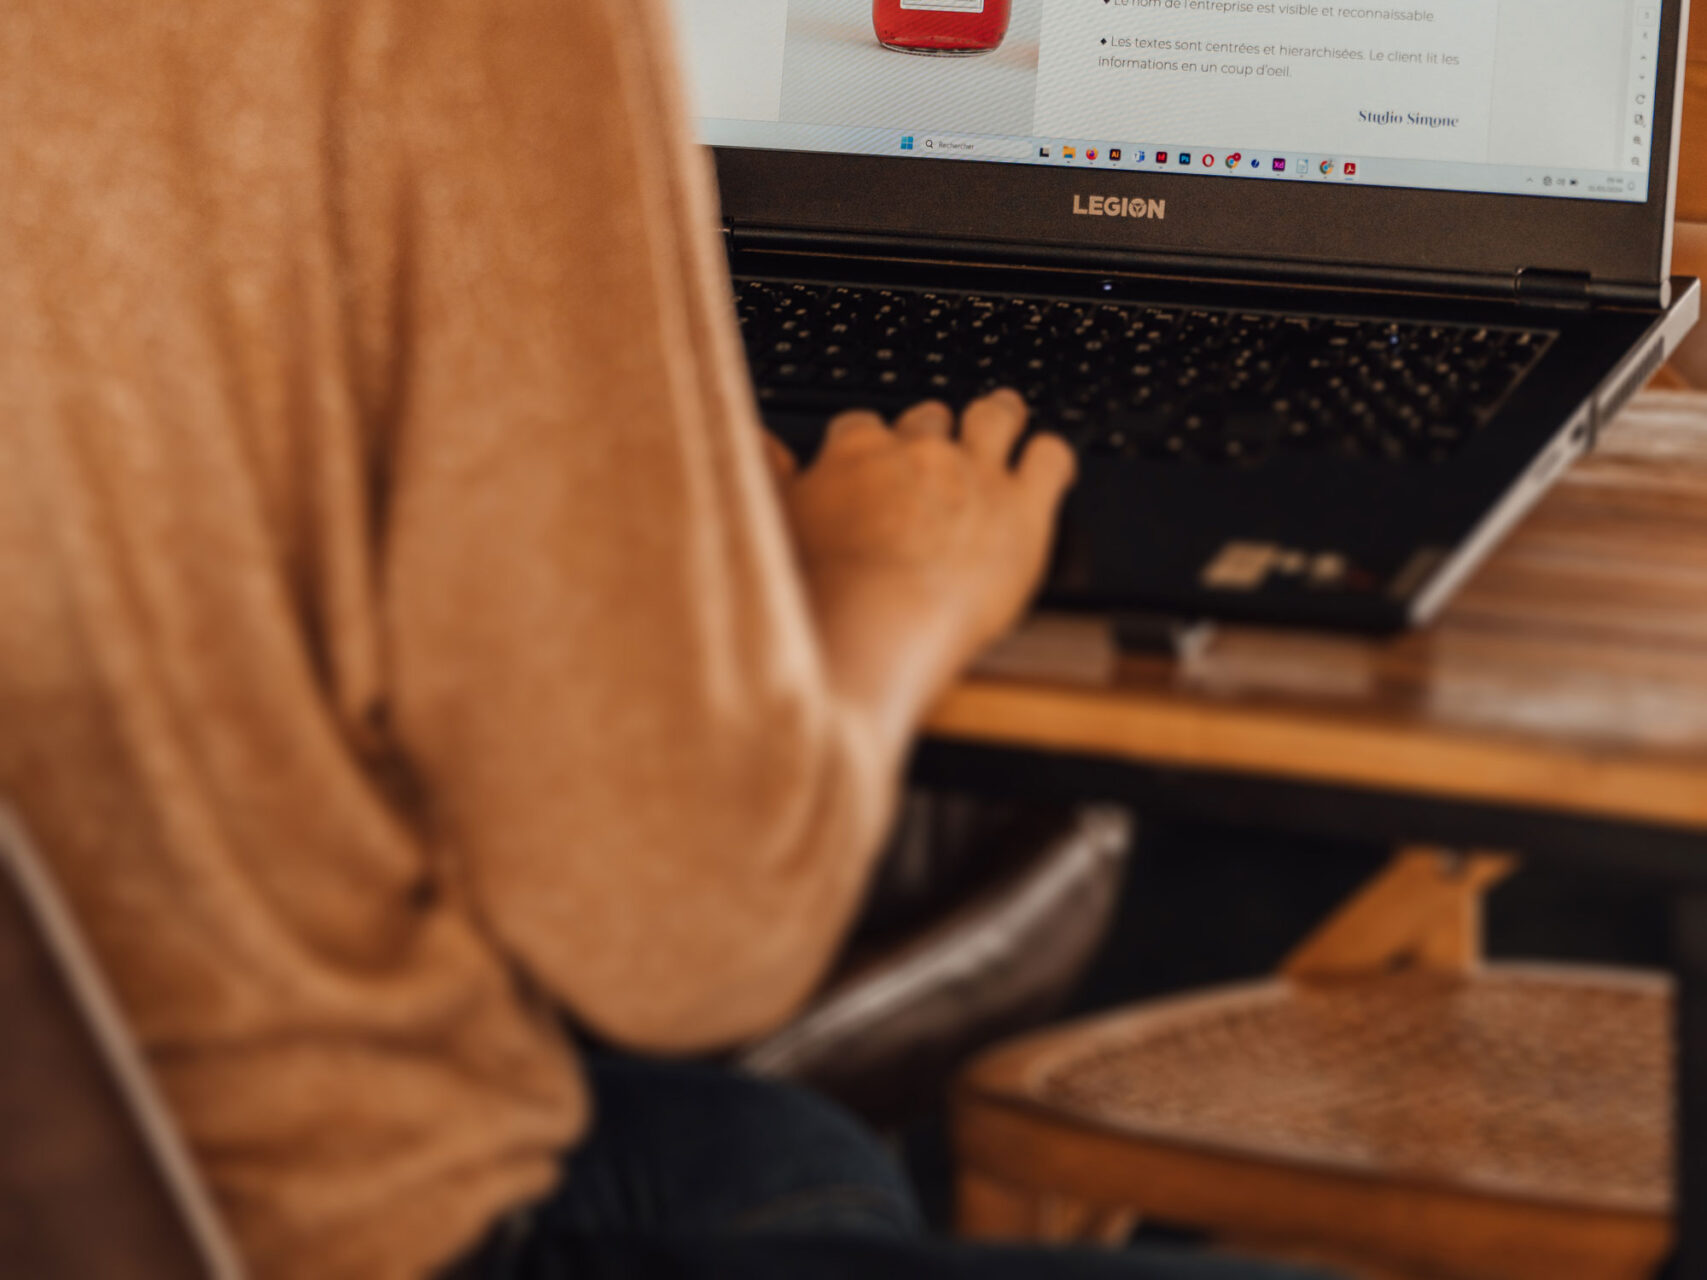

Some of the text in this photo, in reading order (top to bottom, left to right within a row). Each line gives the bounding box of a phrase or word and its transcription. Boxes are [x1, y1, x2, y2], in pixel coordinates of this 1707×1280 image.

[1257, 2, 1275, 13] est
[1278, 4, 1318, 16] visible
[1321, 6, 1334, 17] et
[1338, 7, 1434, 21] reconnaissable
[1111, 36, 1132, 47] Les
[1135, 37, 1172, 50] textes
[1174, 40, 1201, 51] sont
[1205, 41, 1259, 55] centrées
[1263, 44, 1275, 55] et
[1369, 48, 1384, 61] Le
[1387, 50, 1422, 64] client
[1426, 51, 1438, 64] lit
[1441, 52, 1460, 65] les
[1181, 62, 1197, 71] en
[1200, 63, 1217, 73] un
[1221, 64, 1253, 77] coup
[1358, 110, 1459, 128] Studio Simone
[938, 141, 974, 150] Rechercher
[1072, 194, 1166, 219] LEGION
